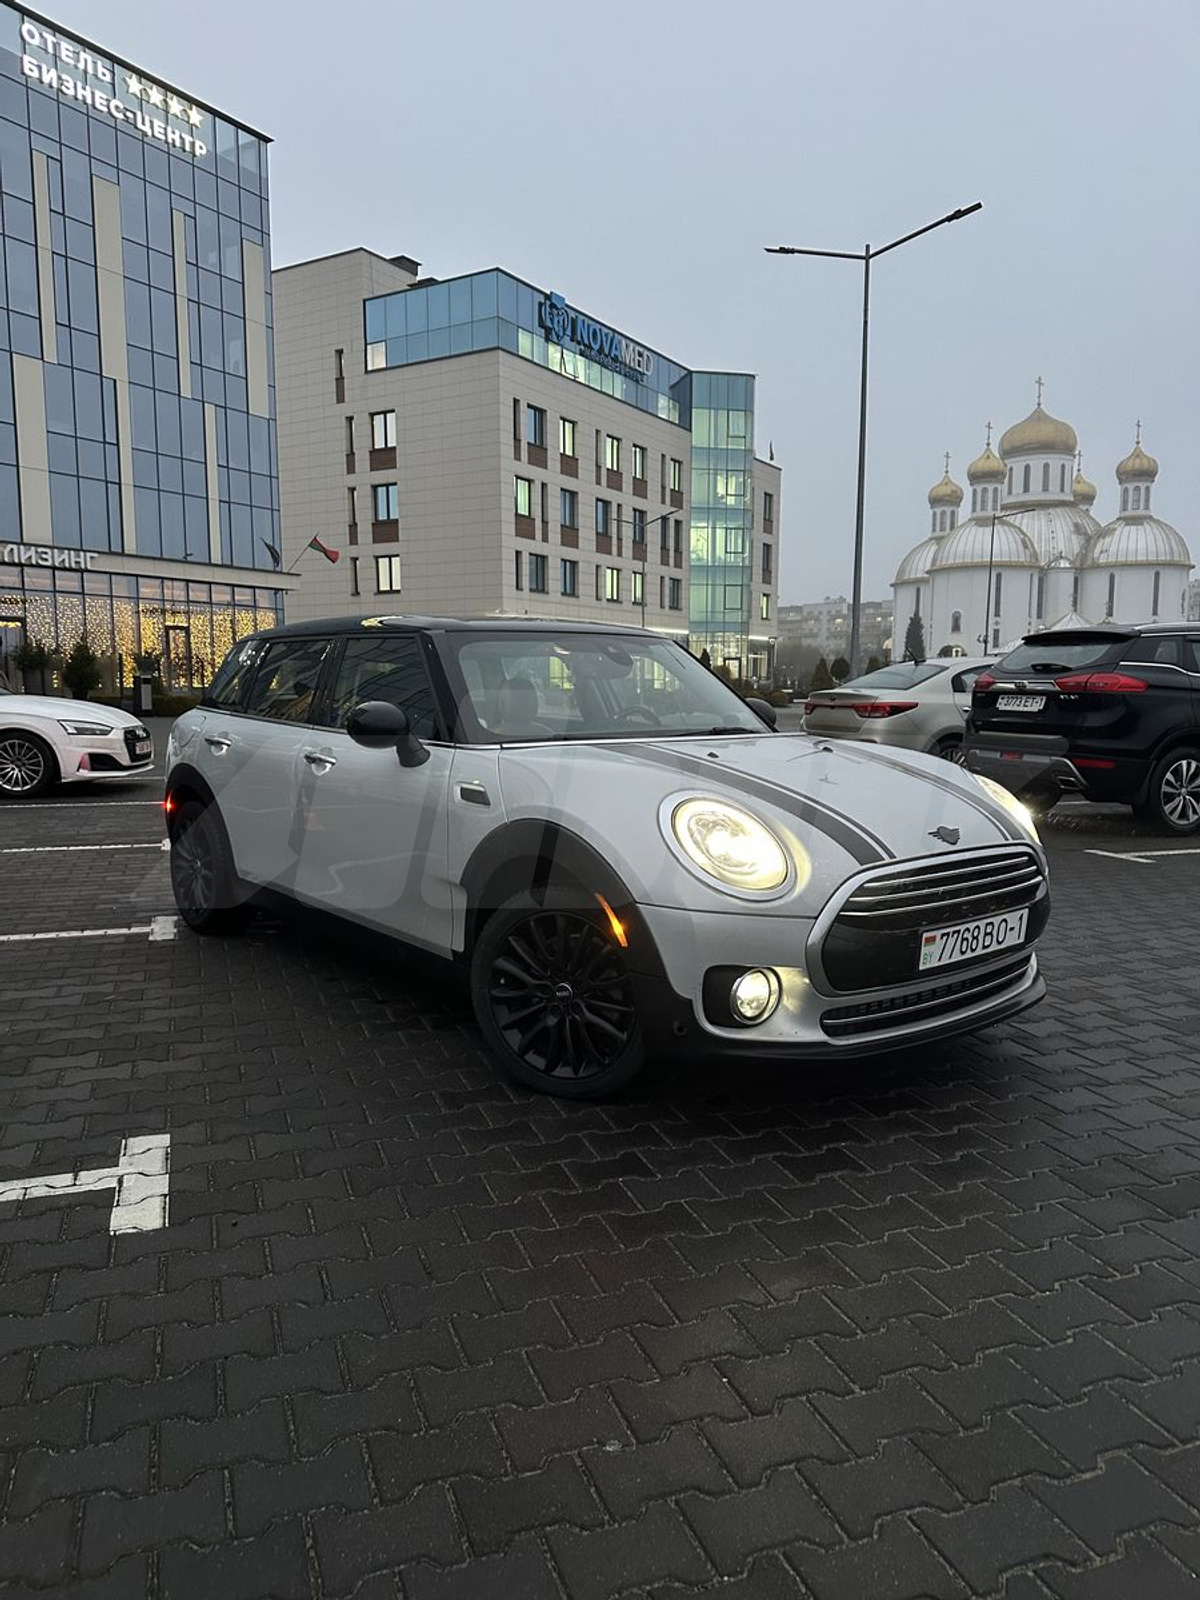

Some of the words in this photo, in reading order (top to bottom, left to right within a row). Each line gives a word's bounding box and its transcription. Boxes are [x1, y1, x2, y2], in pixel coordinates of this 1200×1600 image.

[21, 22, 112, 83] ОТЕЛЬ
[22, 54, 208, 157] БИЗНЕС-ЦЕНТР
[577, 315, 653, 375] NOVAMED
[4, 544, 99, 570] ЛИЗИНГ
